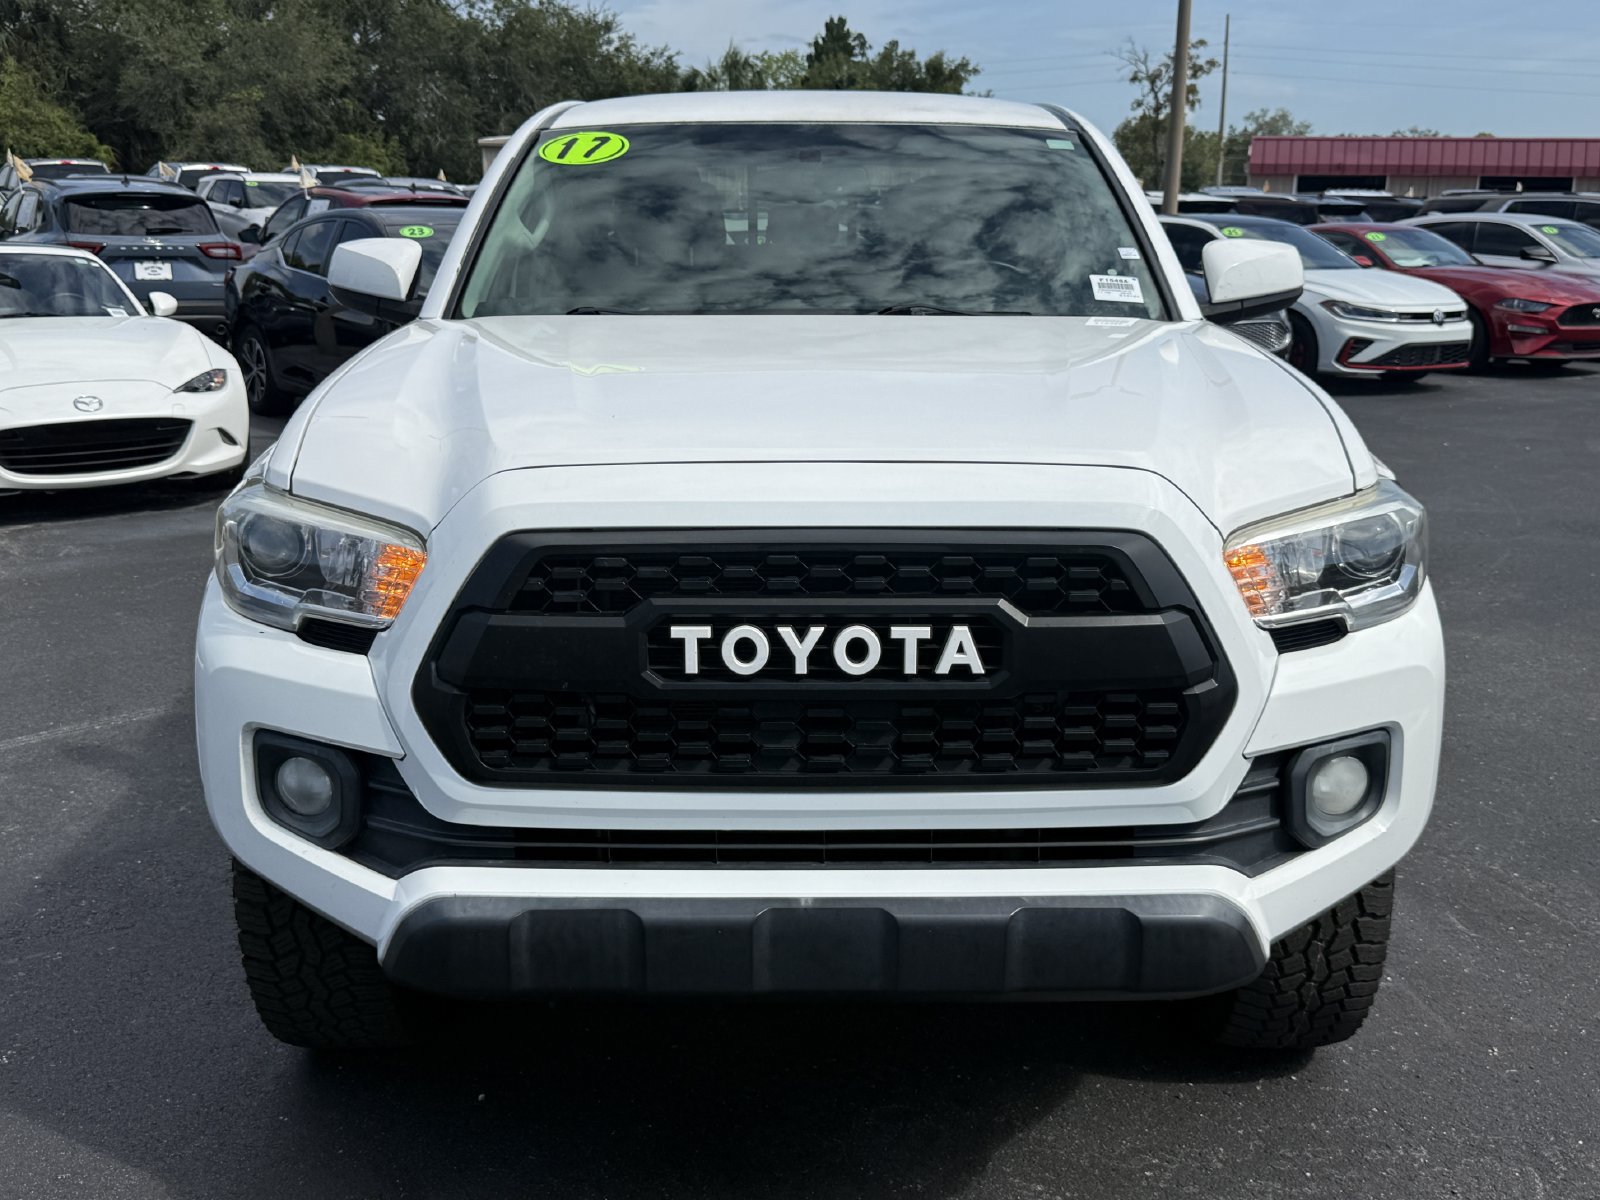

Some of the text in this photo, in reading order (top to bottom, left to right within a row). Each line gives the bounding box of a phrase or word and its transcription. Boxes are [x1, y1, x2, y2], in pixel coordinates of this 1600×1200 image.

[557, 137, 612, 160] 17
[408, 227, 425, 236] 23
[671, 625, 985, 675] TOYOTA
